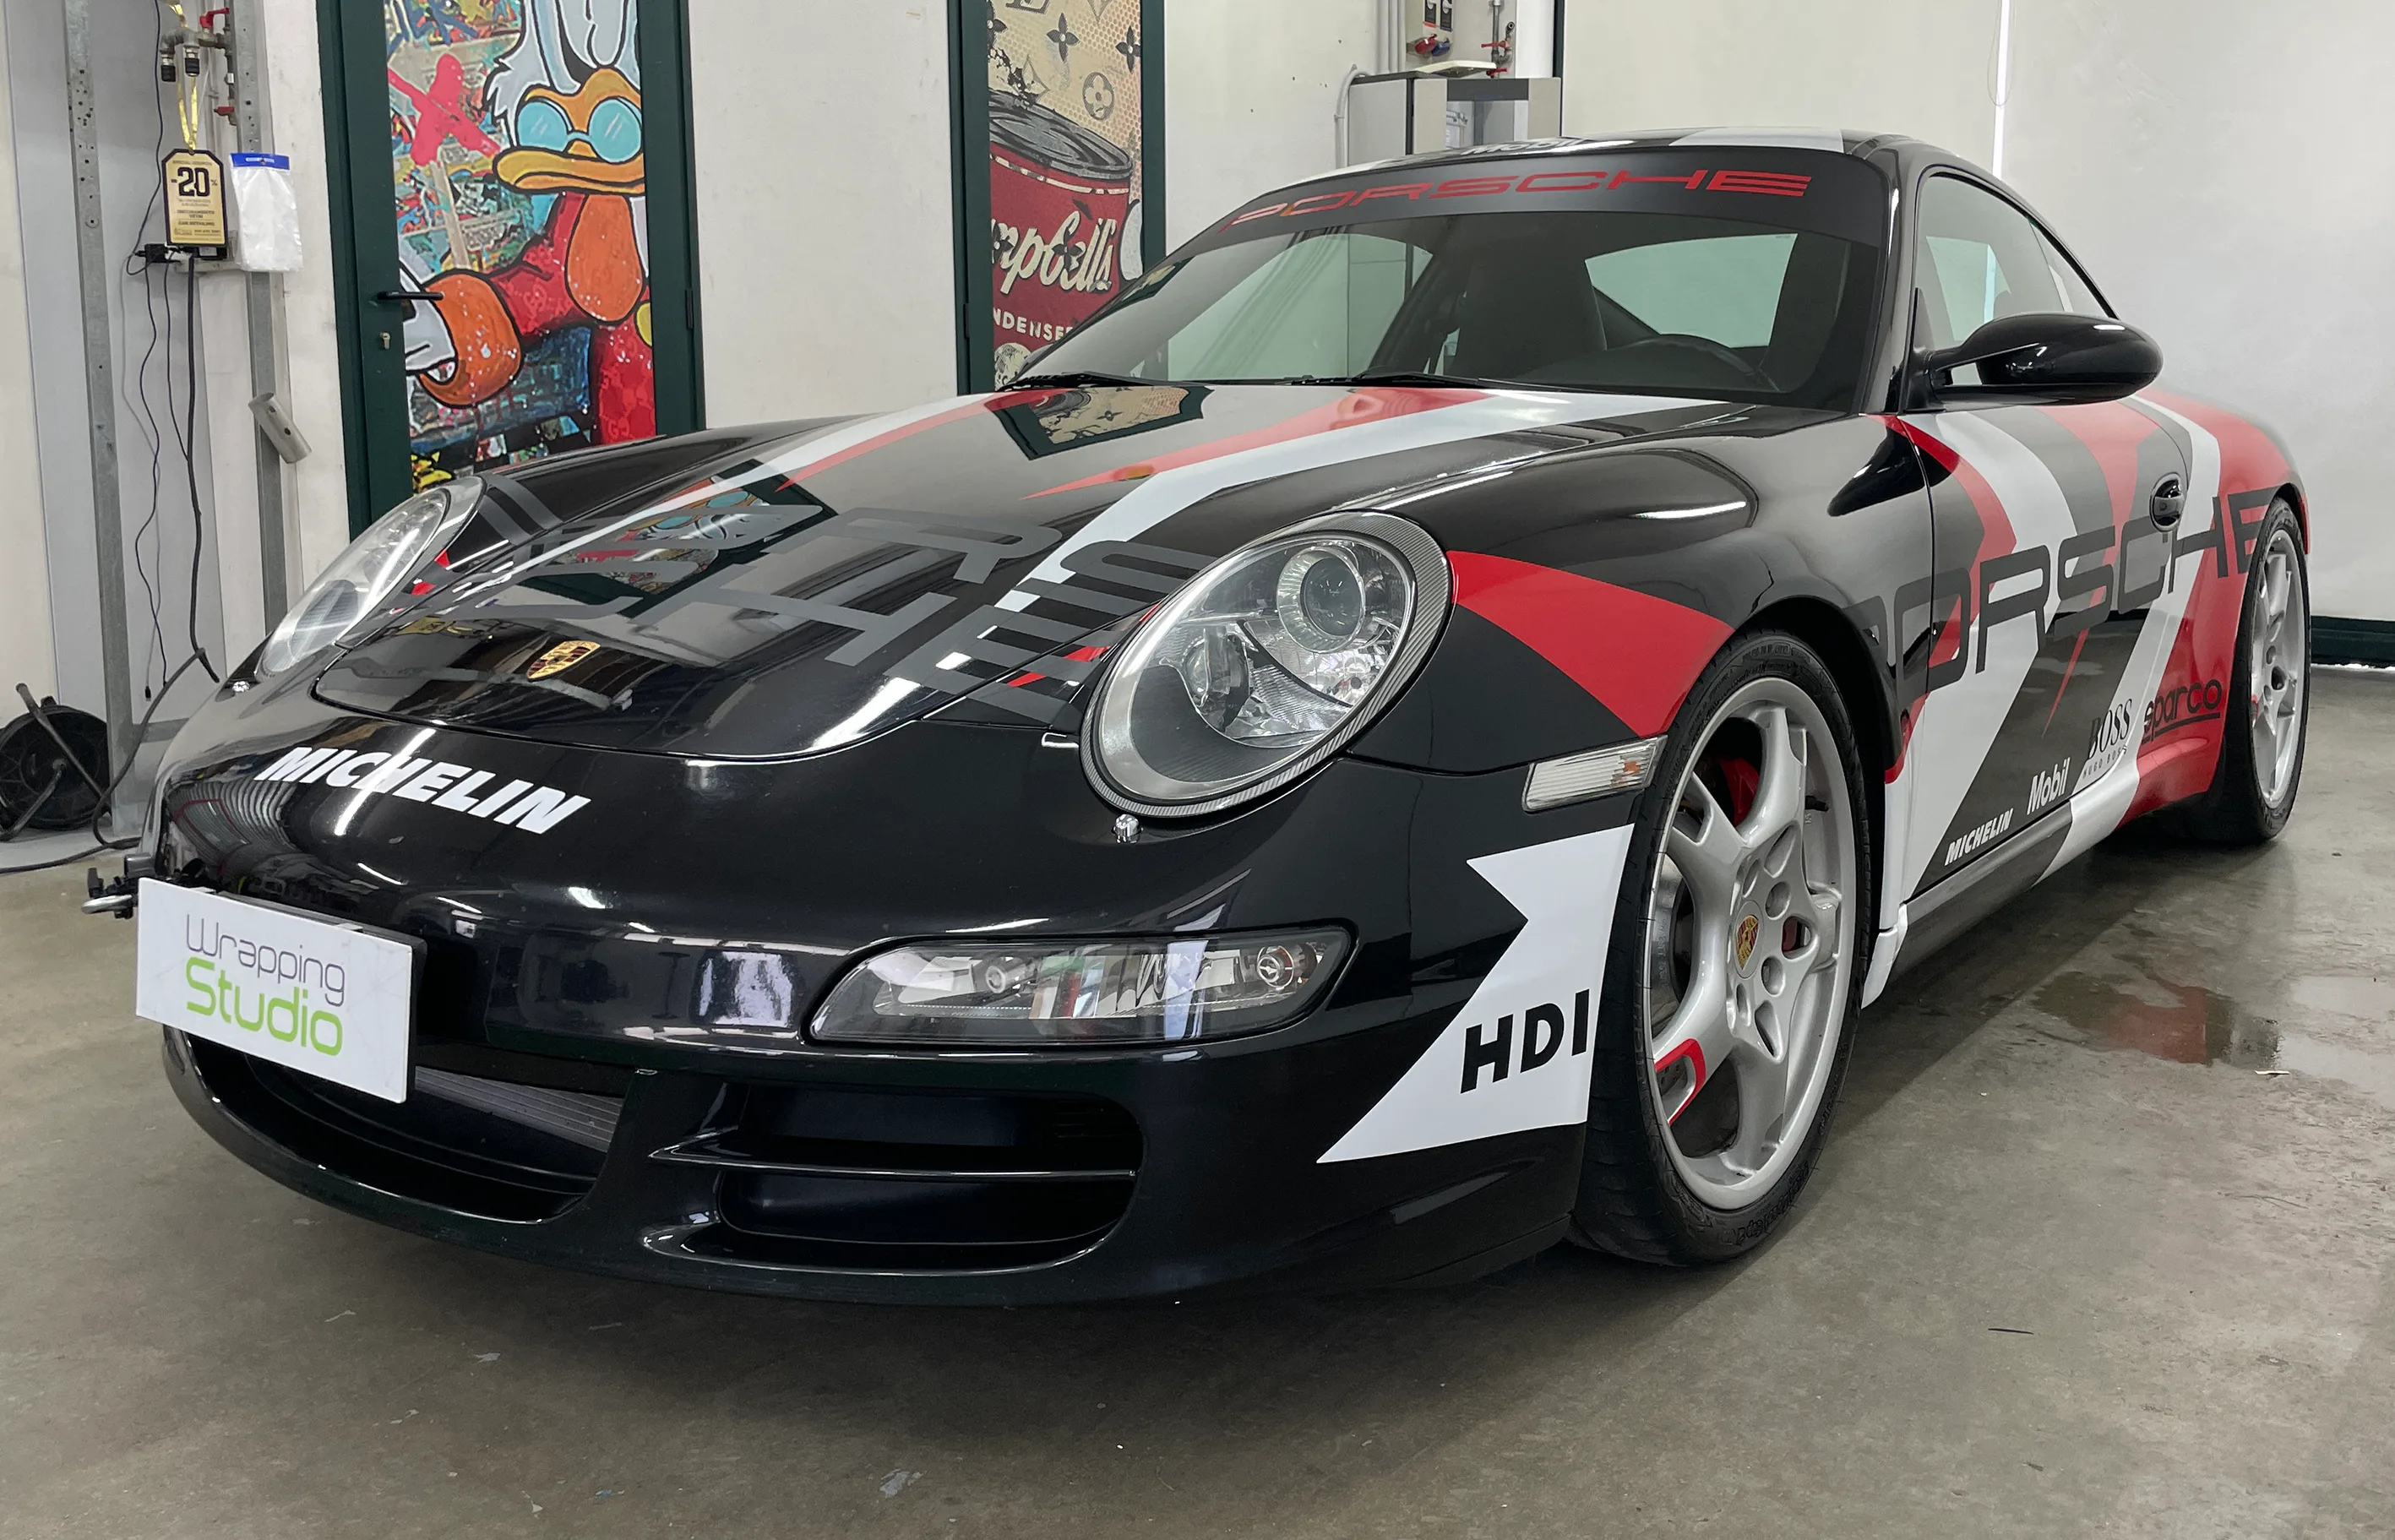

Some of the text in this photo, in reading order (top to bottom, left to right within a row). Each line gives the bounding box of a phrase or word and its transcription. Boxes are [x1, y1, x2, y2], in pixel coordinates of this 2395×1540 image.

[1217, 169, 1812, 235] PORSCHE
[993, 307, 1074, 342] NDENSE
[253, 746, 592, 835] MICHELIN
[2027, 756, 2071, 816] Mobil
[1944, 808, 2014, 867] MICHELIN
[186, 913, 346, 1008] Wrapping
[185, 955, 344, 1057] Studio
[1460, 988, 1591, 1094] HDI
